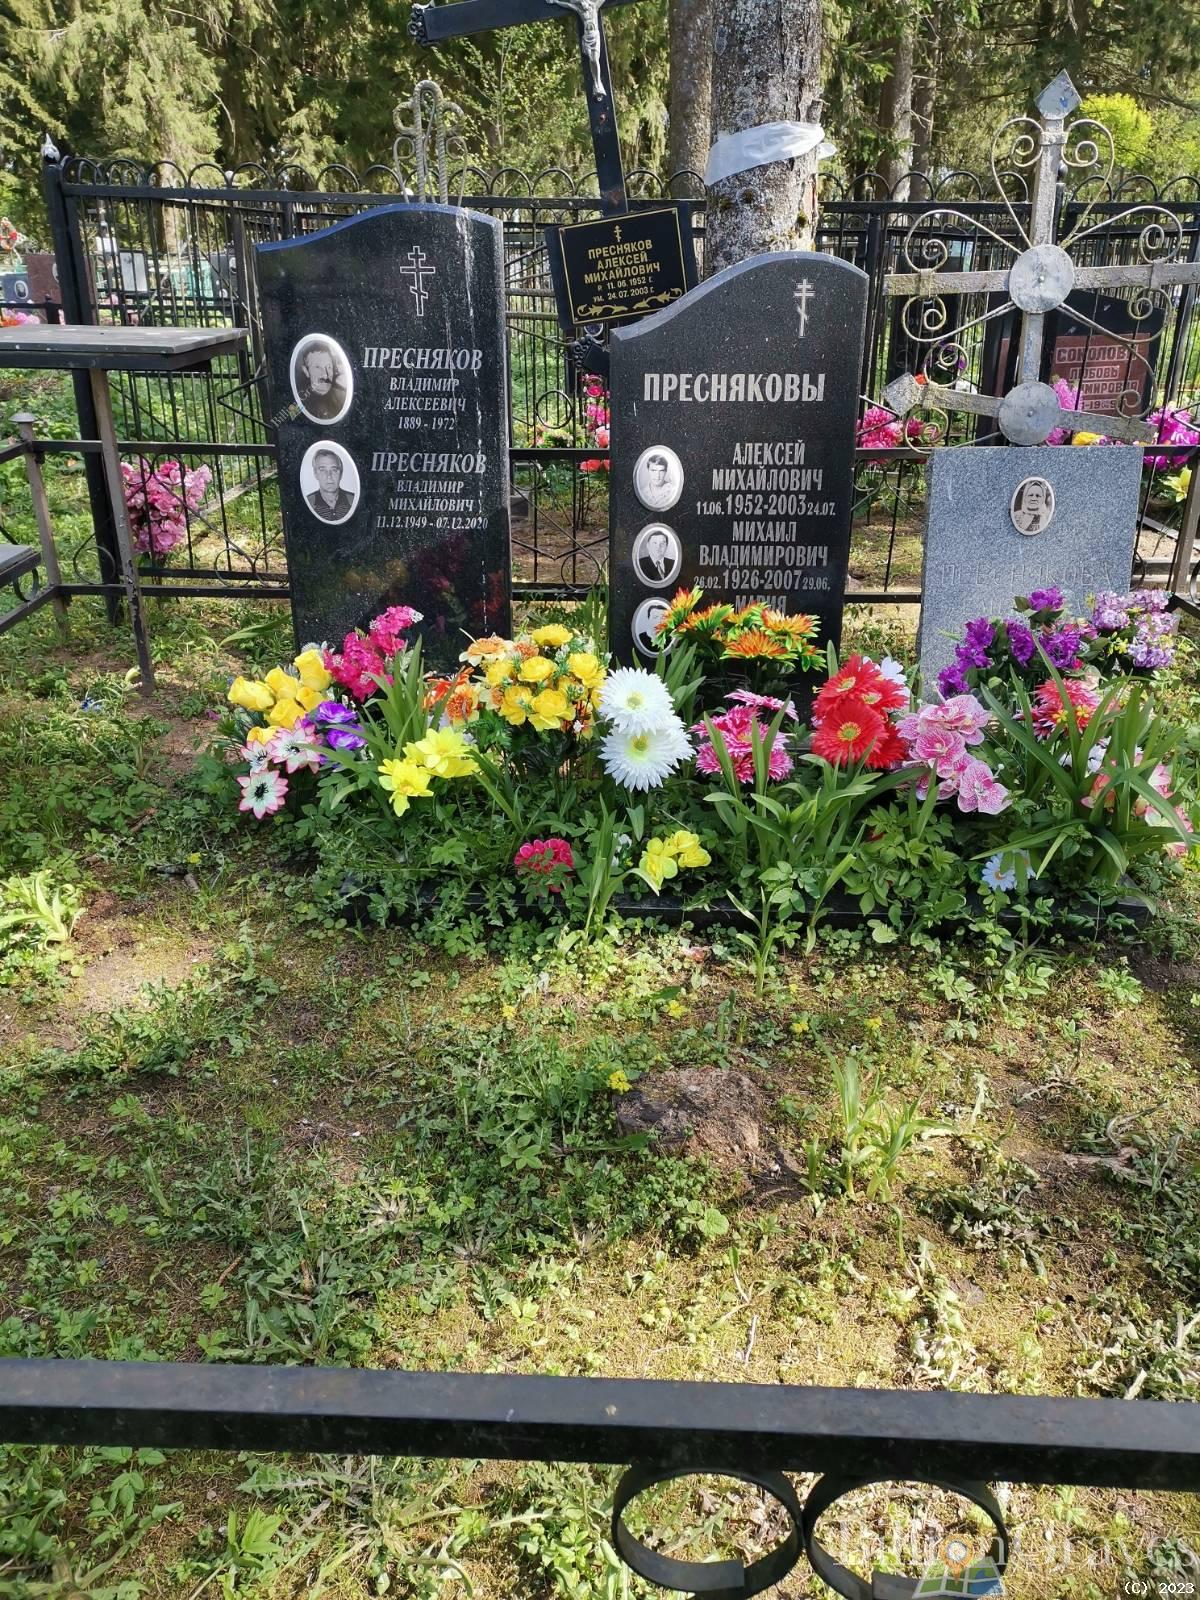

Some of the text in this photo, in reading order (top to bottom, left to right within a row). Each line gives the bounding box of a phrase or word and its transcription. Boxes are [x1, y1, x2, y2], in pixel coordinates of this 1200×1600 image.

[588, 239, 653, 260] ПРЕСНЯКОВ
[597, 251, 648, 271] АЛЕКСЕЙ
[584, 262, 660, 284] МИХАЙЛОВИЧ
[362, 347, 483, 370] ПРЕСНЯКОВ
[389, 377, 460, 393] ВЛАДИМИР
[643, 373, 826, 402] ПРЕСНЯКОВЫ
[383, 397, 466, 411] АЛЕКСЕЕВИЧ
[398, 416, 422, 430] 1889
[431, 417, 455, 430] 1972
[370, 452, 487, 473] ПРЕСНЯКОВ
[732, 440, 806, 465] АЛЕКСЕЙ
[396, 480, 464, 494] ВЛАДИМИР
[711, 465, 823, 491] МИХАЙЛОВИЧ
[388, 496, 474, 512] МИХАЙЛОВИЧ
[376, 516, 427, 528] 11.12.1949
[436, 517, 489, 529] 07.12.2020
[732, 521, 797, 542] МИХАИЛ
[699, 545, 828, 569] ВЛАДИМИРОВИЧ
